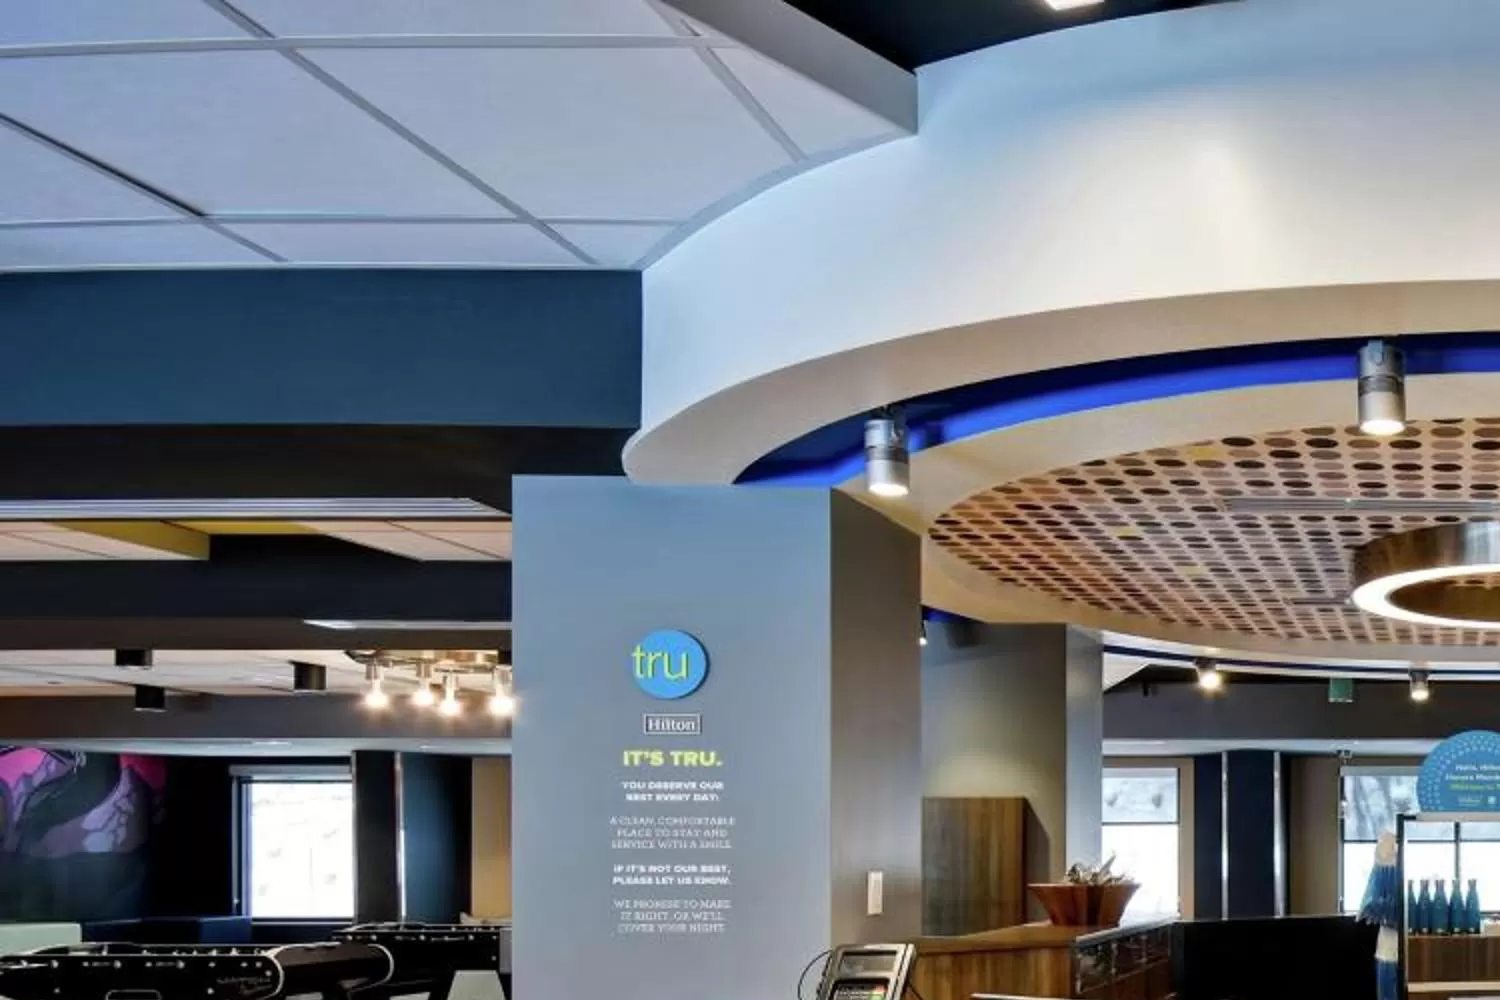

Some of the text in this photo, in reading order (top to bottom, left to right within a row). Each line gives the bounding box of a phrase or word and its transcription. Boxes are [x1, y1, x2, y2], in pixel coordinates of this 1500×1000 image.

[632, 644, 689, 679] tru
[649, 718, 696, 731] Hilton
[623, 751, 723, 767] IT'S TRU.
[621, 781, 724, 790] YOU DESERVE OUR
[625, 792, 653, 801] BEST
[656, 792, 691, 801] EVERY
[703, 828, 729, 837] AND
[613, 864, 624, 873] IF
[647, 864, 671, 873] NOT
[673, 864, 698, 873] OUR
[612, 875, 654, 885] PLEASE
[655, 875, 675, 885] LET
[677, 875, 692, 885] US
